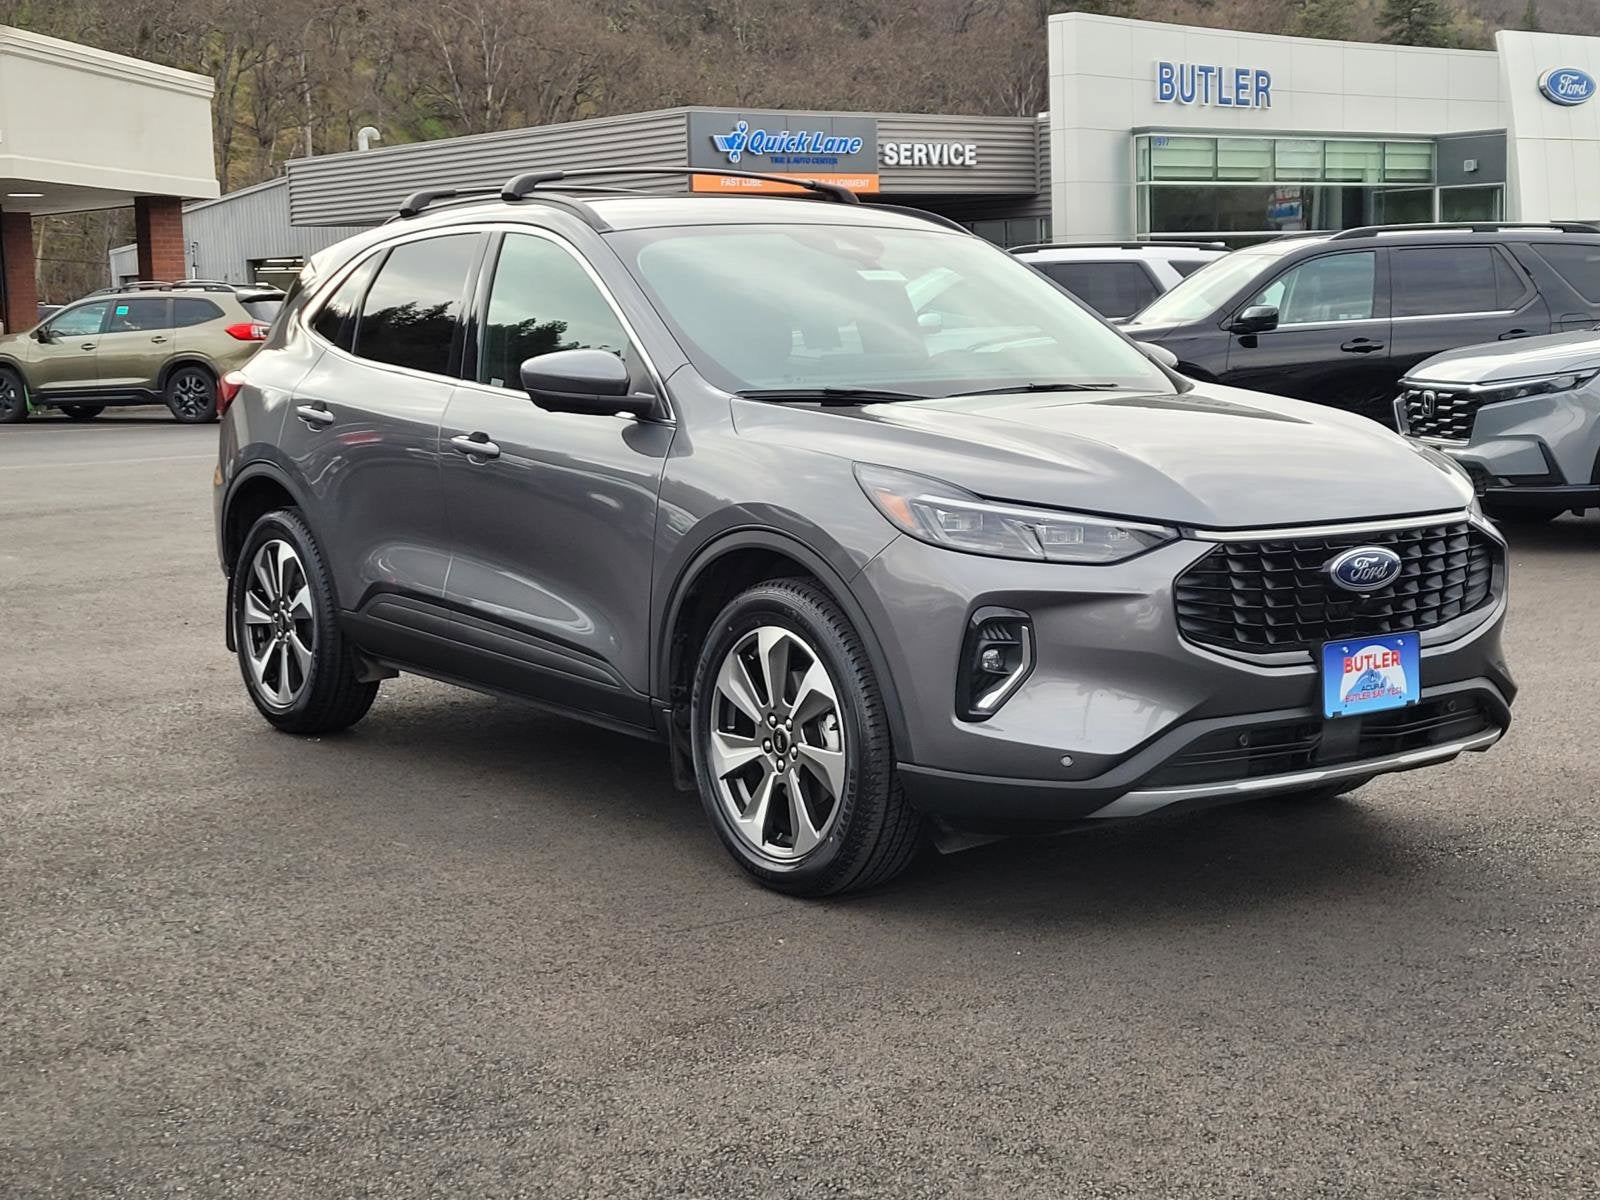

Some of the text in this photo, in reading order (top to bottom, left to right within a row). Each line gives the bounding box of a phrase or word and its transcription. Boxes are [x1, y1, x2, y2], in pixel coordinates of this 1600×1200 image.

[1157, 60, 1272, 109] BUTLER
[1558, 73, 1588, 95] Ford
[750, 129, 863, 155] Quick Lane
[884, 142, 977, 165] SERVICE
[720, 178, 740, 187] FAST
[1350, 556, 1391, 583] Ford
[1344, 649, 1401, 674] BUTLER
[1361, 682, 1385, 691] ACURA
